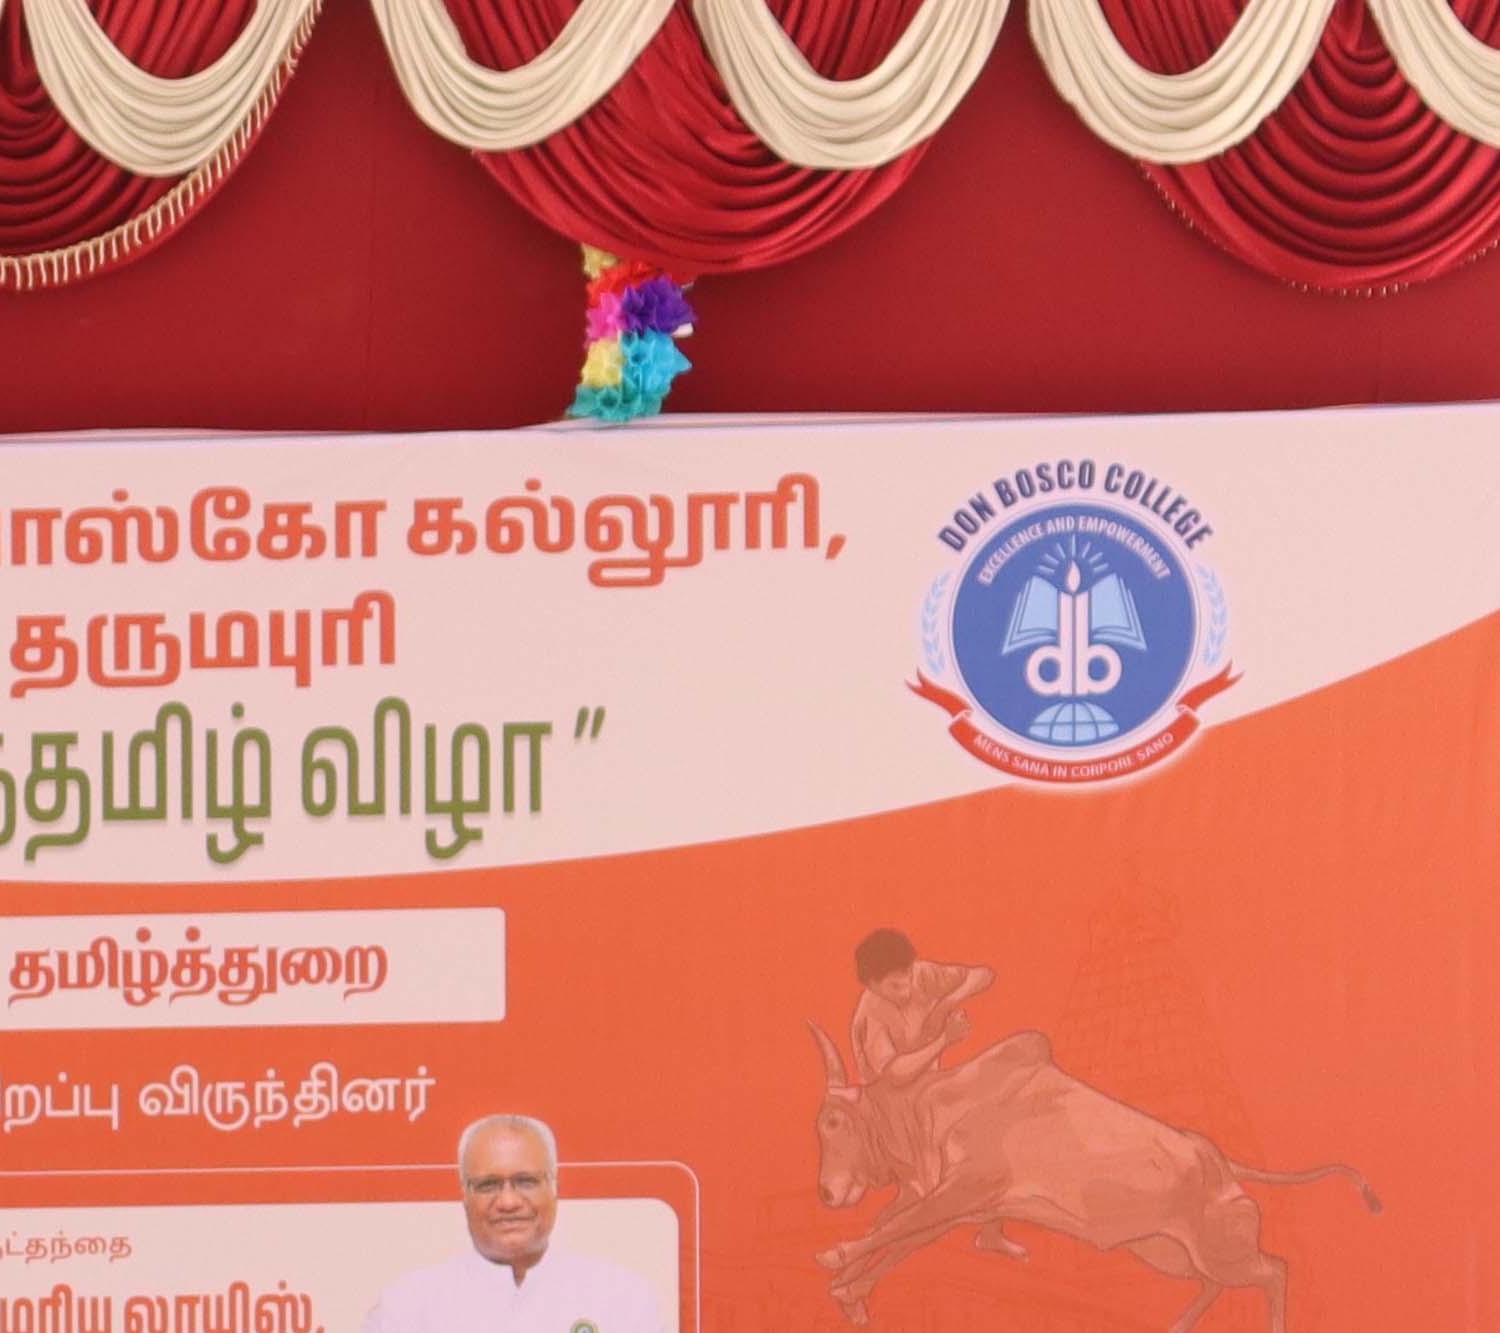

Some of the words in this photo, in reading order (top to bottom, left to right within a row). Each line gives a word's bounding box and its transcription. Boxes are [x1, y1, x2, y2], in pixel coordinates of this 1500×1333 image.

[407, 474, 845, 588] கல்லூரி,
[938, 494, 996, 552] DON
[994, 459, 1096, 508] BOSCO
[1104, 463, 1214, 549] COLLEGE
[976, 522, 1043, 586] EXCELLENCE
[1047, 515, 1075, 533] AND
[1078, 515, 1171, 579] EMPOWERMENT
[10, 590, 398, 698] தருமபுரி
[1012, 755, 1050, 777] SANA
[1053, 766, 1068, 778] IN
[1136, 731, 1175, 762] SANO
[8, 927, 387, 1007] தமிழ்த்துறை
[139, 1062, 436, 1131] விருந்தினர்
